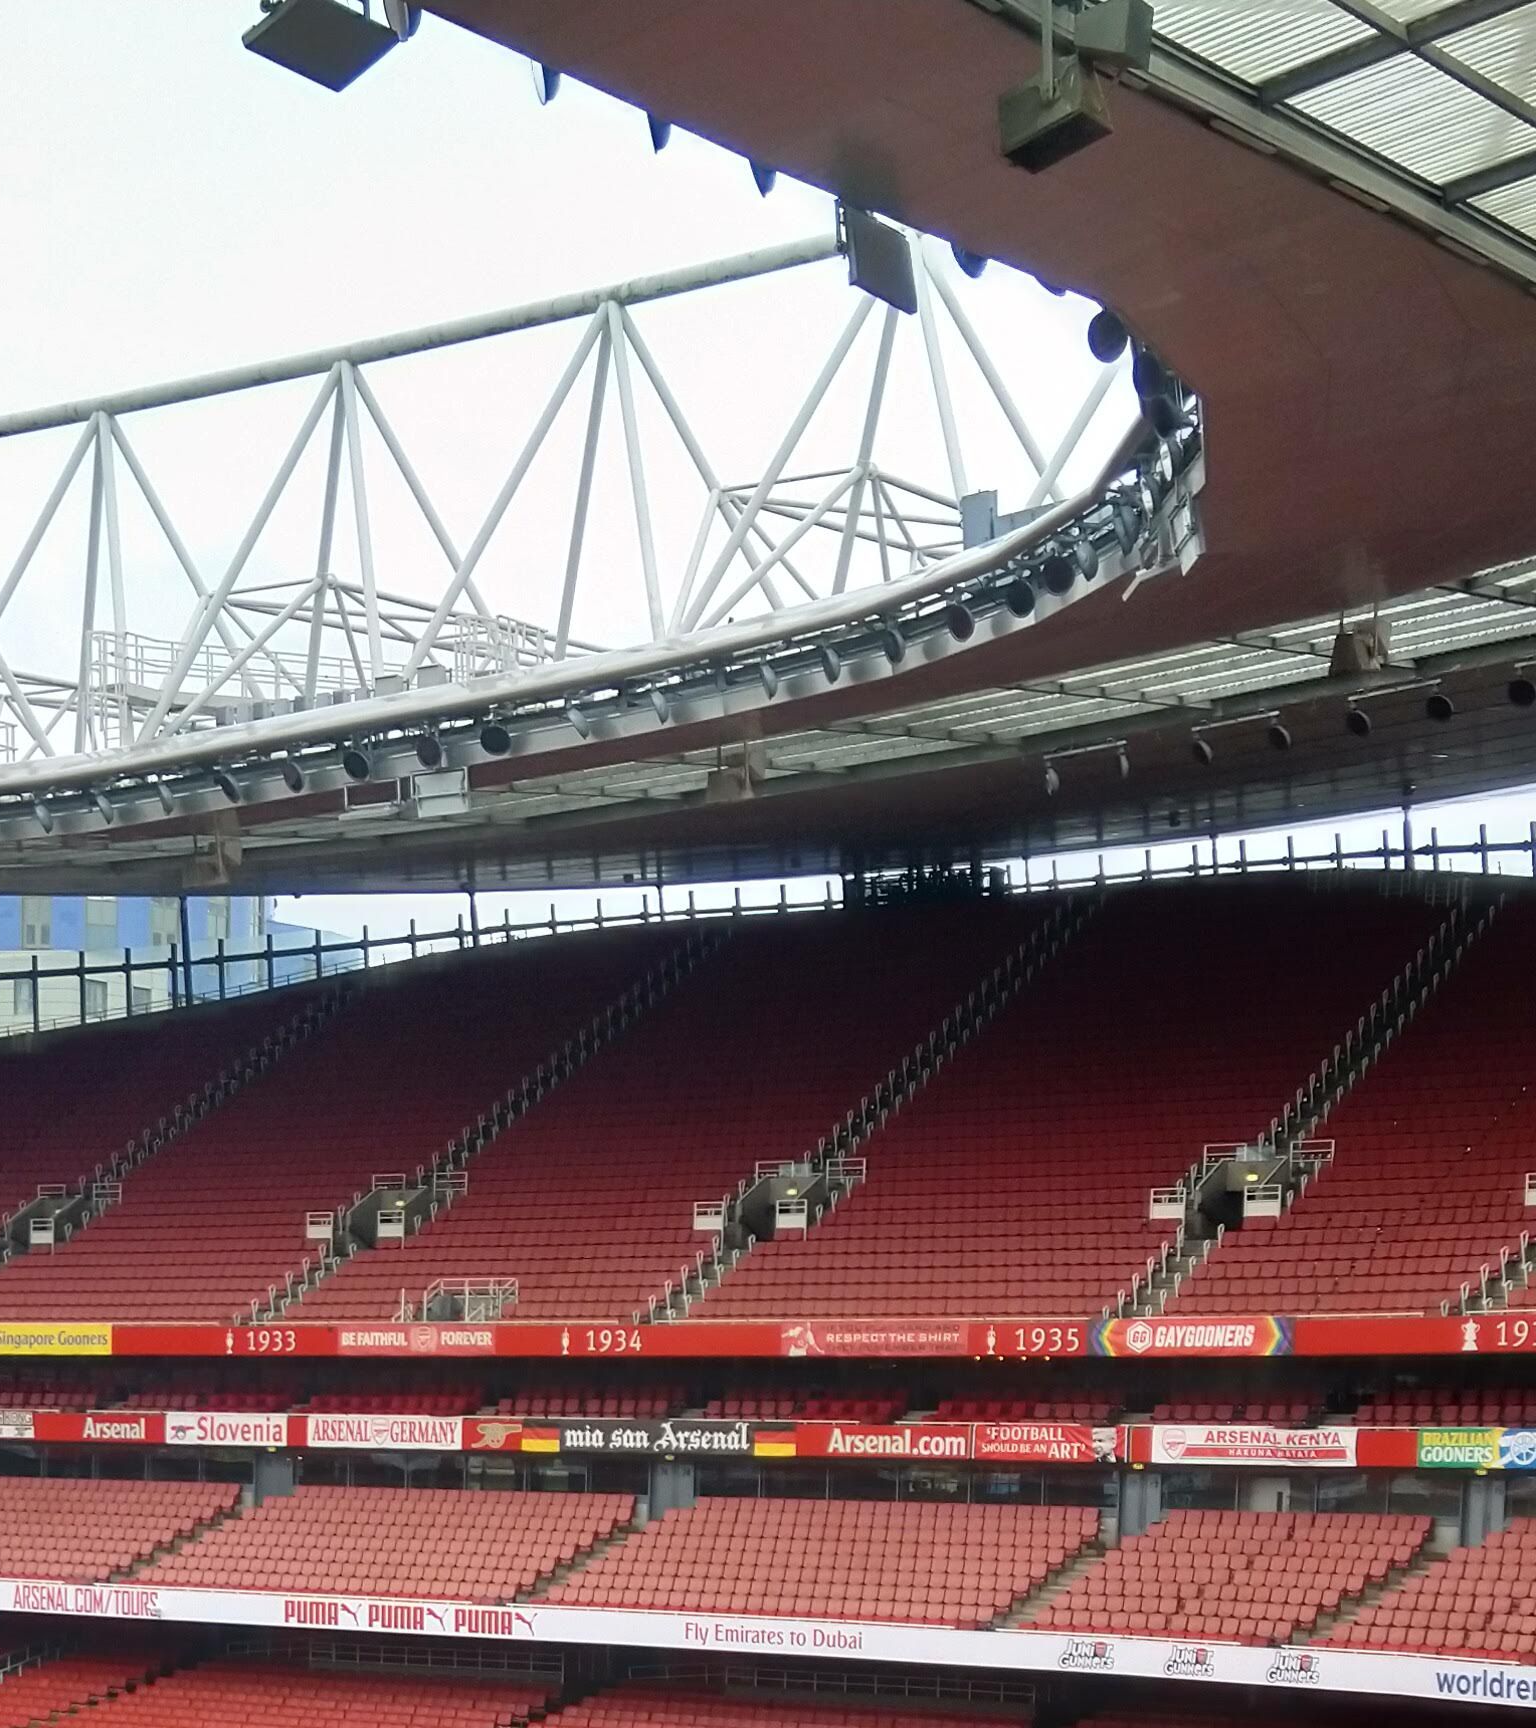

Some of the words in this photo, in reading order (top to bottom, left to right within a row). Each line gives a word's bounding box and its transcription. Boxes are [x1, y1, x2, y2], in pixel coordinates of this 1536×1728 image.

[58, 1330, 108, 1346] Gooners
[246, 1330, 296, 1352] 1933
[341, 1331, 356, 1347] BE
[357, 1331, 408, 1347] FAITHFUL
[440, 1331, 493, 1347] FOREVER
[586, 1330, 642, 1352] 1934
[826, 1333, 887, 1343] RESPECT
[889, 1333, 916, 1343] THE
[918, 1333, 960, 1343] SHIRT
[1015, 1328, 1079, 1352] 1935
[1155, 1325, 1255, 1348] GAYGOONERS
[83, 1417, 145, 1439] Arsenal
[197, 1416, 283, 1442] Slovenia
[312, 1419, 371, 1442] ARSENAL
[390, 1420, 458, 1444] GERMANY
[565, 1424, 604, 1449] mia
[609, 1427, 650, 1449] san
[653, 1421, 750, 1452] Arsenal
[1204, 1430, 1281, 1445] ARSENAL
[1286, 1431, 1342, 1446] KENYA
[1422, 1431, 1493, 1446] BRAZILIAN
[827, 1428, 966, 1457] Arsenal.com
[982, 1443, 1019, 1454] SHOULD
[1019, 1443, 1032, 1454] BE
[1032, 1443, 1047, 1454] AN
[1228, 1448, 1272, 1457] HAKUNA
[1420, 1446, 1494, 1463] GOONERS
[13, 1585, 159, 1618] ARSENAL.COM/TOURS
[284, 1600, 339, 1625] PUMA
[368, 1604, 425, 1630] PUMA
[454, 1608, 513, 1635] PUMA
[684, 1622, 709, 1645] Fly
[715, 1623, 784, 1645] Emirates
[790, 1630, 806, 1646] to
[813, 1628, 863, 1650] Dubai
